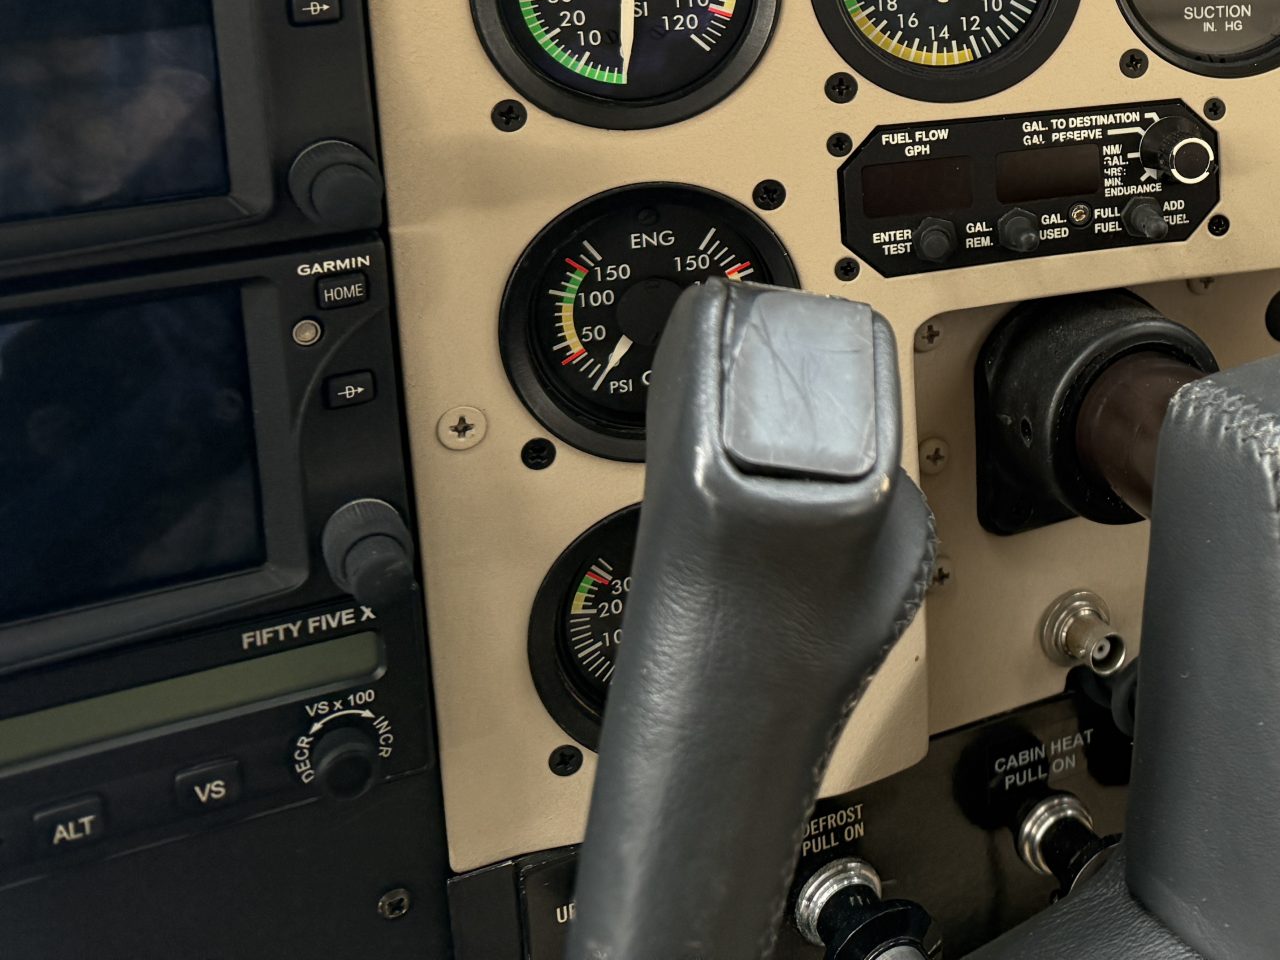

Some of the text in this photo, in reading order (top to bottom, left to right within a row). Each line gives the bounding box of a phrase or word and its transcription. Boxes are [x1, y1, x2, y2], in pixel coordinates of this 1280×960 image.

[560, 10, 585, 26] 20
[897, 13, 918, 28] 16
[1184, 5, 1251, 20] SUCTION
[662, 14, 698, 31] 120
[960, 16, 981, 31] 12
[1203, 20, 1243, 32] IN. HG
[577, 30, 601, 46] 10
[928, 25, 950, 40] 14
[1022, 112, 1140, 133] GAL. TO DESTINATION
[882, 129, 949, 146] FUEL FLOW
[905, 144, 930, 157] GPH
[1105, 183, 1162, 197] ENDURANCE
[1094, 207, 1120, 219] FULL
[1163, 200, 1184, 211] ADD
[966, 221, 993, 234] GAL.
[1041, 213, 1067, 226] GAL.
[1094, 221, 1122, 233] FUEL
[630, 230, 675, 249] ENG
[872, 229, 912, 243] ENTER
[1039, 227, 1069, 240] USED
[882, 242, 912, 255] TEST
[966, 236, 994, 249] REM.
[297, 255, 370, 276] GARMIN
[674, 254, 710, 272] 150
[594, 264, 631, 282] 150
[324, 284, 364, 302] HOME
[578, 290, 614, 308] 100
[582, 324, 606, 342] 50
[610, 379, 633, 394] PSI
[598, 599, 622, 618] 20
[242, 606, 376, 650] FIFTY FIVE X
[305, 701, 329, 717] VS
[348, 689, 375, 707] 100
[373, 716, 394, 758] INCR
[994, 728, 1094, 773] CABIN HEAT
[294, 736, 314, 784] DECR
[1005, 754, 1076, 790] PULL ON
[194, 780, 227, 804] VS
[52, 814, 96, 845] ALT
[803, 822, 864, 856] PULL ON
